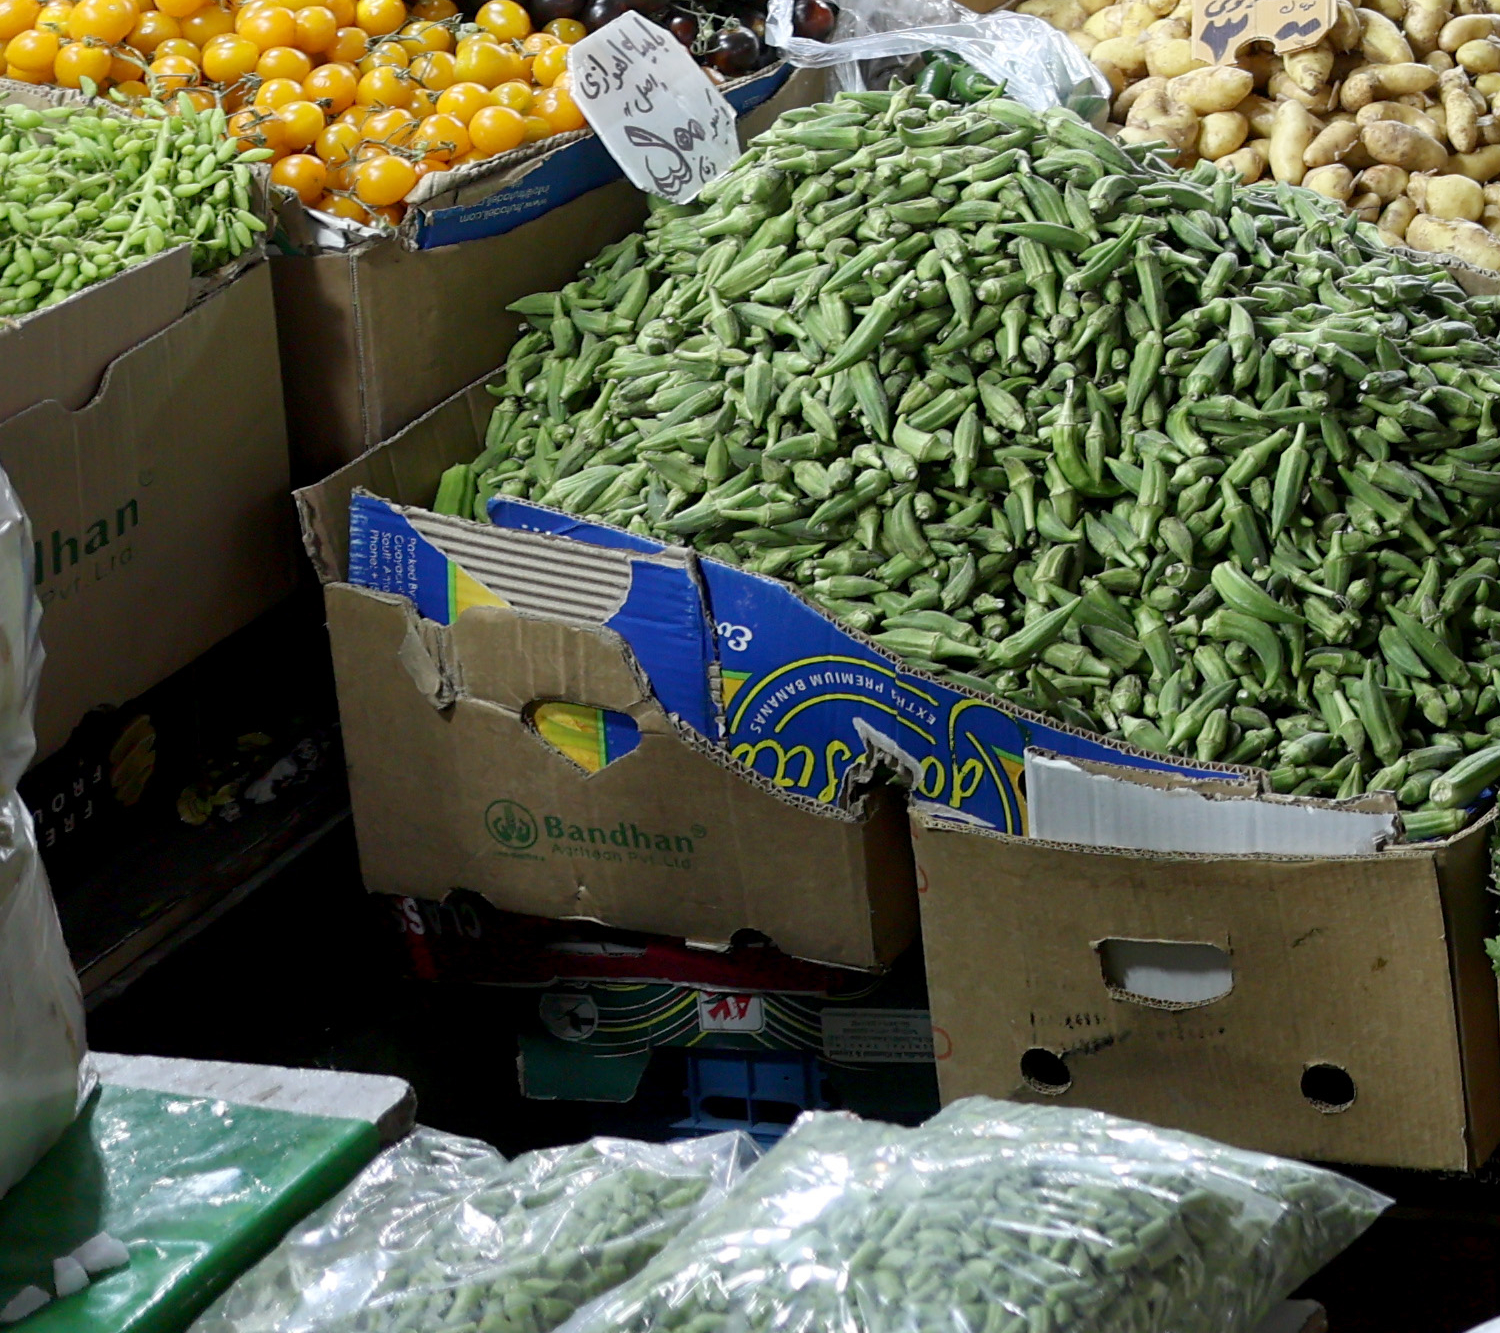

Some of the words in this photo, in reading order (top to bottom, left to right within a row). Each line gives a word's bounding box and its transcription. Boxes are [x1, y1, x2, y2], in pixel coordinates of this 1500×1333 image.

[406, 536, 419, 581] Packed
[807, 670, 885, 695] PREMIUM
[747, 678, 807, 735] BANANAS
[888, 688, 938, 726] EXTRA
[543, 815, 695, 854] Bandhan
